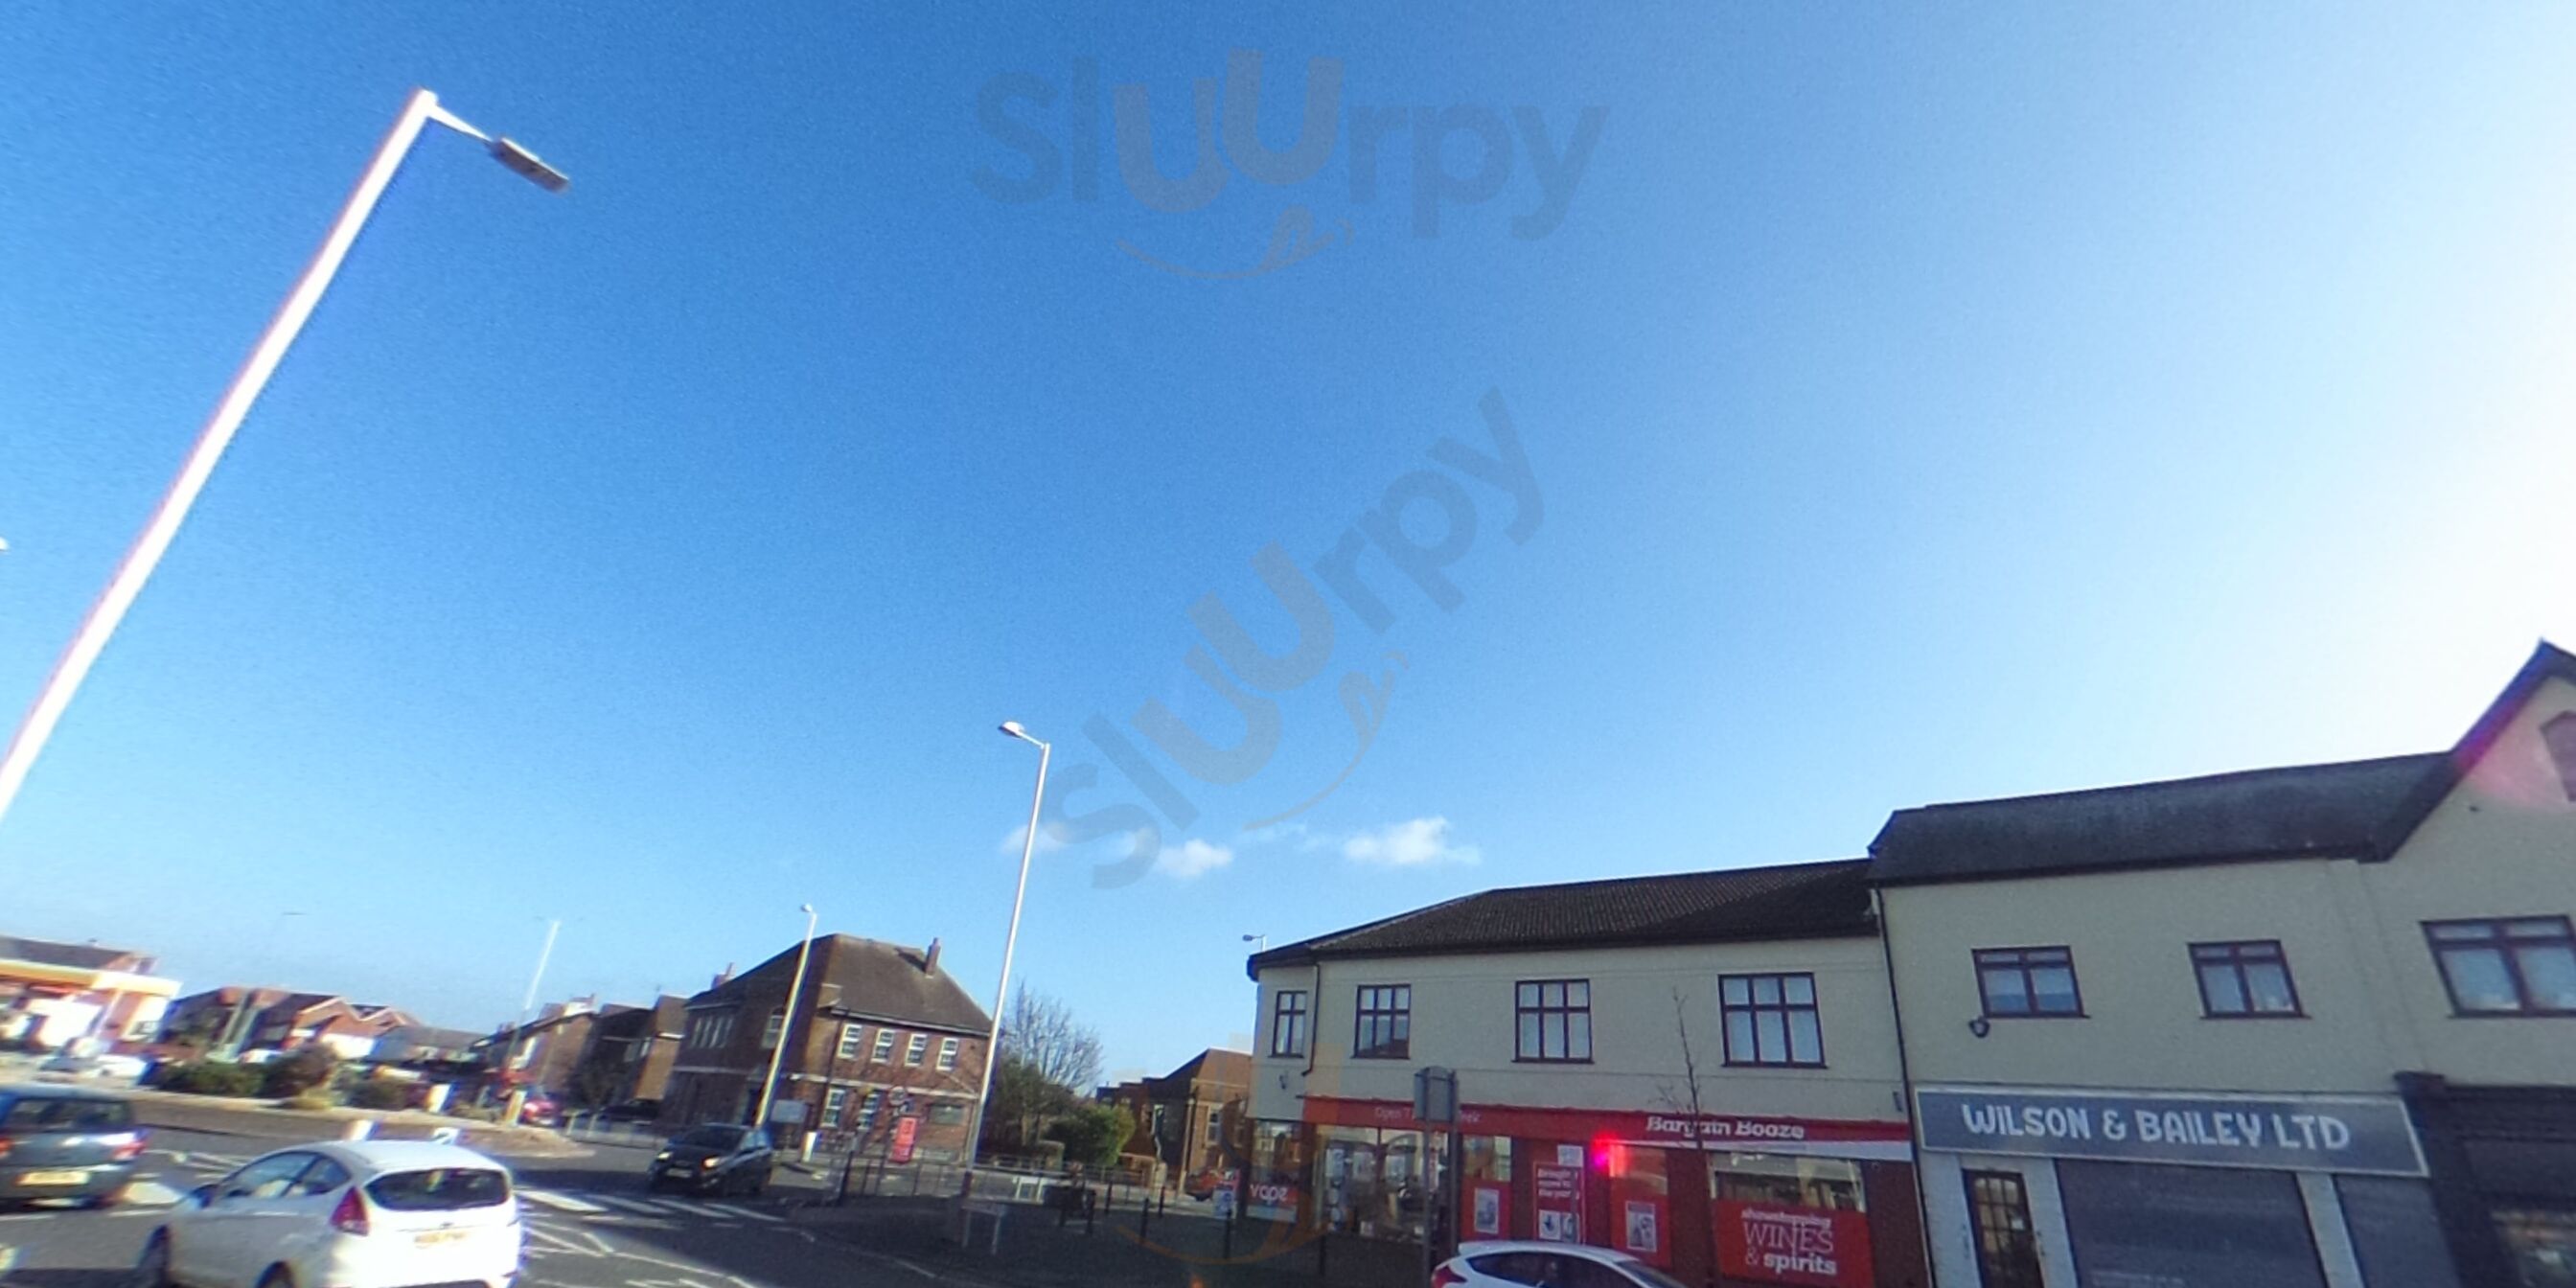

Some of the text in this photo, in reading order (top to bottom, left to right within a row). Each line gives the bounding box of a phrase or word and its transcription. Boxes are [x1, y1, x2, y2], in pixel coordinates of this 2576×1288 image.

[1645, 1116, 1805, 1140] Bargain Booze
[1961, 1103, 2350, 1152] WILSON & BAILEY LTD
[1742, 1220, 1834, 1254] WINES
[1744, 1247, 1838, 1276] & spirits
